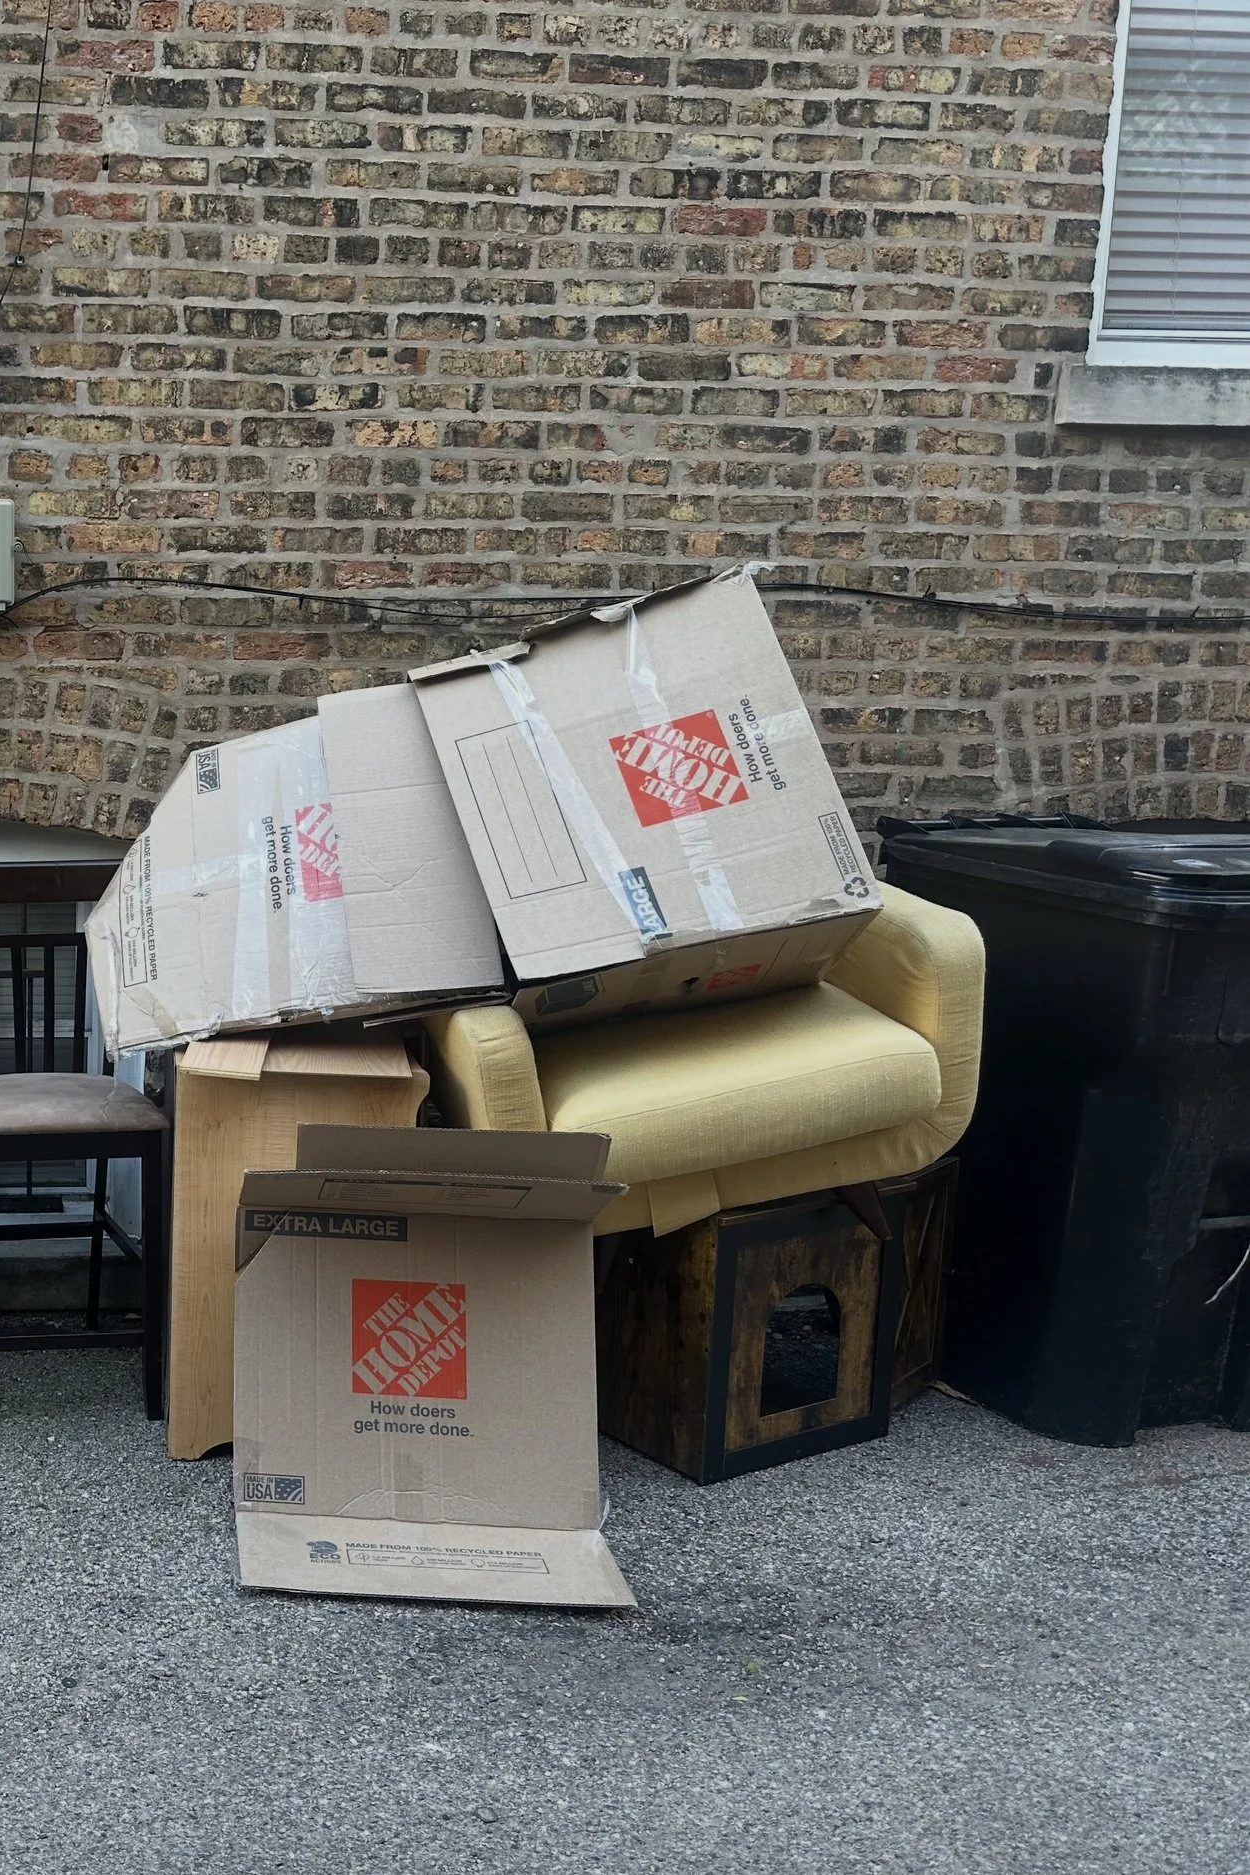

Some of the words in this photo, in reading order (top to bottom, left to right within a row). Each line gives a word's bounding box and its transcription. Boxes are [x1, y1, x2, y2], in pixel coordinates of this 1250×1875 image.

[649, 722, 731, 767] DEPOT
[728, 713, 750, 750] doers
[753, 732, 775, 768] more
[615, 732, 743, 806] HOME
[744, 753, 763, 783] How
[766, 768, 787, 791] get
[639, 776, 688, 809] THE
[261, 816, 276, 837] get
[280, 825, 293, 854] How
[830, 816, 843, 837] PAPER
[143, 836, 151, 858] MADE
[266, 840, 279, 873] more
[830, 836, 842, 855] FROM
[840, 838, 858, 873] RECYCLED
[143, 859, 151, 882] FROM
[283, 858, 296, 896] doers
[838, 855, 850, 875] MADE
[144, 883, 152, 904] 100%
[144, 906, 156, 950] RECYCLED
[148, 953, 158, 981] PAPER
[253, 1213, 322, 1233] EXTRA
[328, 1217, 399, 1237] LARGE
[362, 1292, 411, 1337] THE
[352, 1282, 466, 1395] HOME
[396, 1325, 466, 1397] DEPOT
[370, 1400, 405, 1416] How
[410, 1403, 456, 1419] doers
[353, 1419, 380, 1434] get
[384, 1422, 425, 1435] more
[246, 1475, 265, 1483] MADE
[266, 1476, 274, 1484] IN
[246, 1482, 273, 1500] USA
[309, 1552, 342, 1560] ECO
[448, 1547, 504, 1556] RECYCLED
